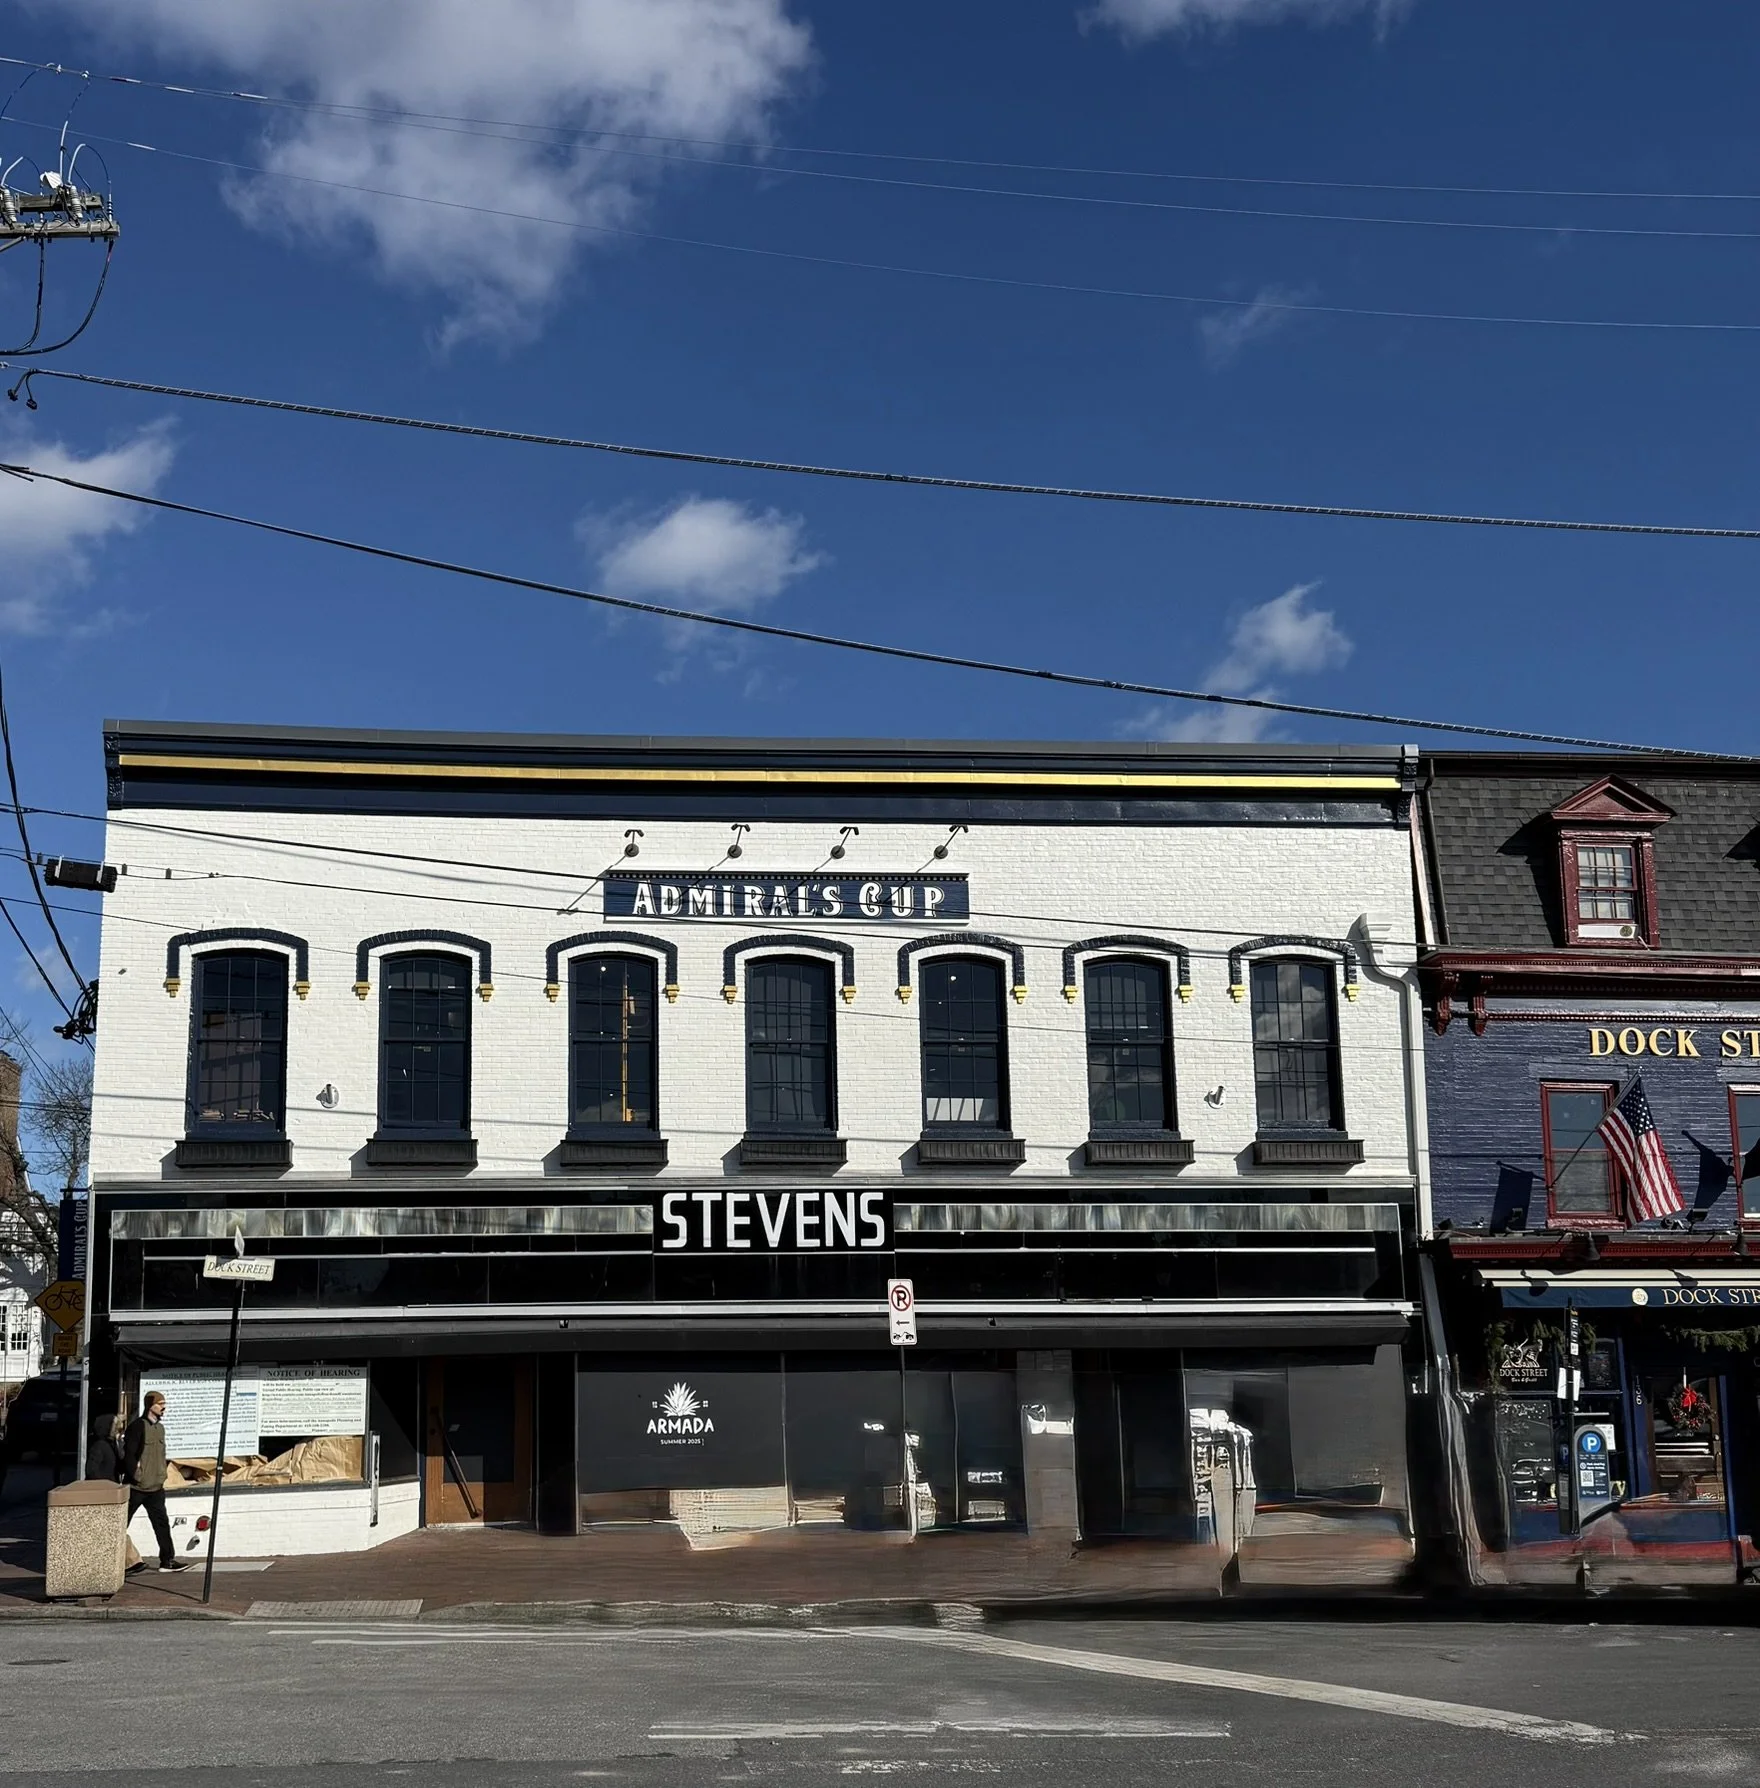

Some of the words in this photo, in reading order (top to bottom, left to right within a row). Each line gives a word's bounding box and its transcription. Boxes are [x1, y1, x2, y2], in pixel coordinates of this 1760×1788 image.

[631, 880, 843, 917] ADMIRAL'S
[859, 881, 945, 917] CUP
[1588, 1027, 1701, 1057] DOCK
[73, 1200, 88, 1223] CUP
[662, 1192, 885, 1248] STEVENS
[71, 1225, 87, 1280] ADMIRAL'S
[236, 1263, 272, 1275] STREET
[1661, 1288, 1724, 1305] DOCK
[267, 1369, 300, 1378] NOTICE
[304, 1369, 314, 1377] OF
[320, 1369, 360, 1377] HEARING
[1499, 1368, 1520, 1377] DOCK
[1521, 1368, 1548, 1377] STREET
[647, 1418, 714, 1434] ARMADA
[1587, 1437, 1597, 1450] P
